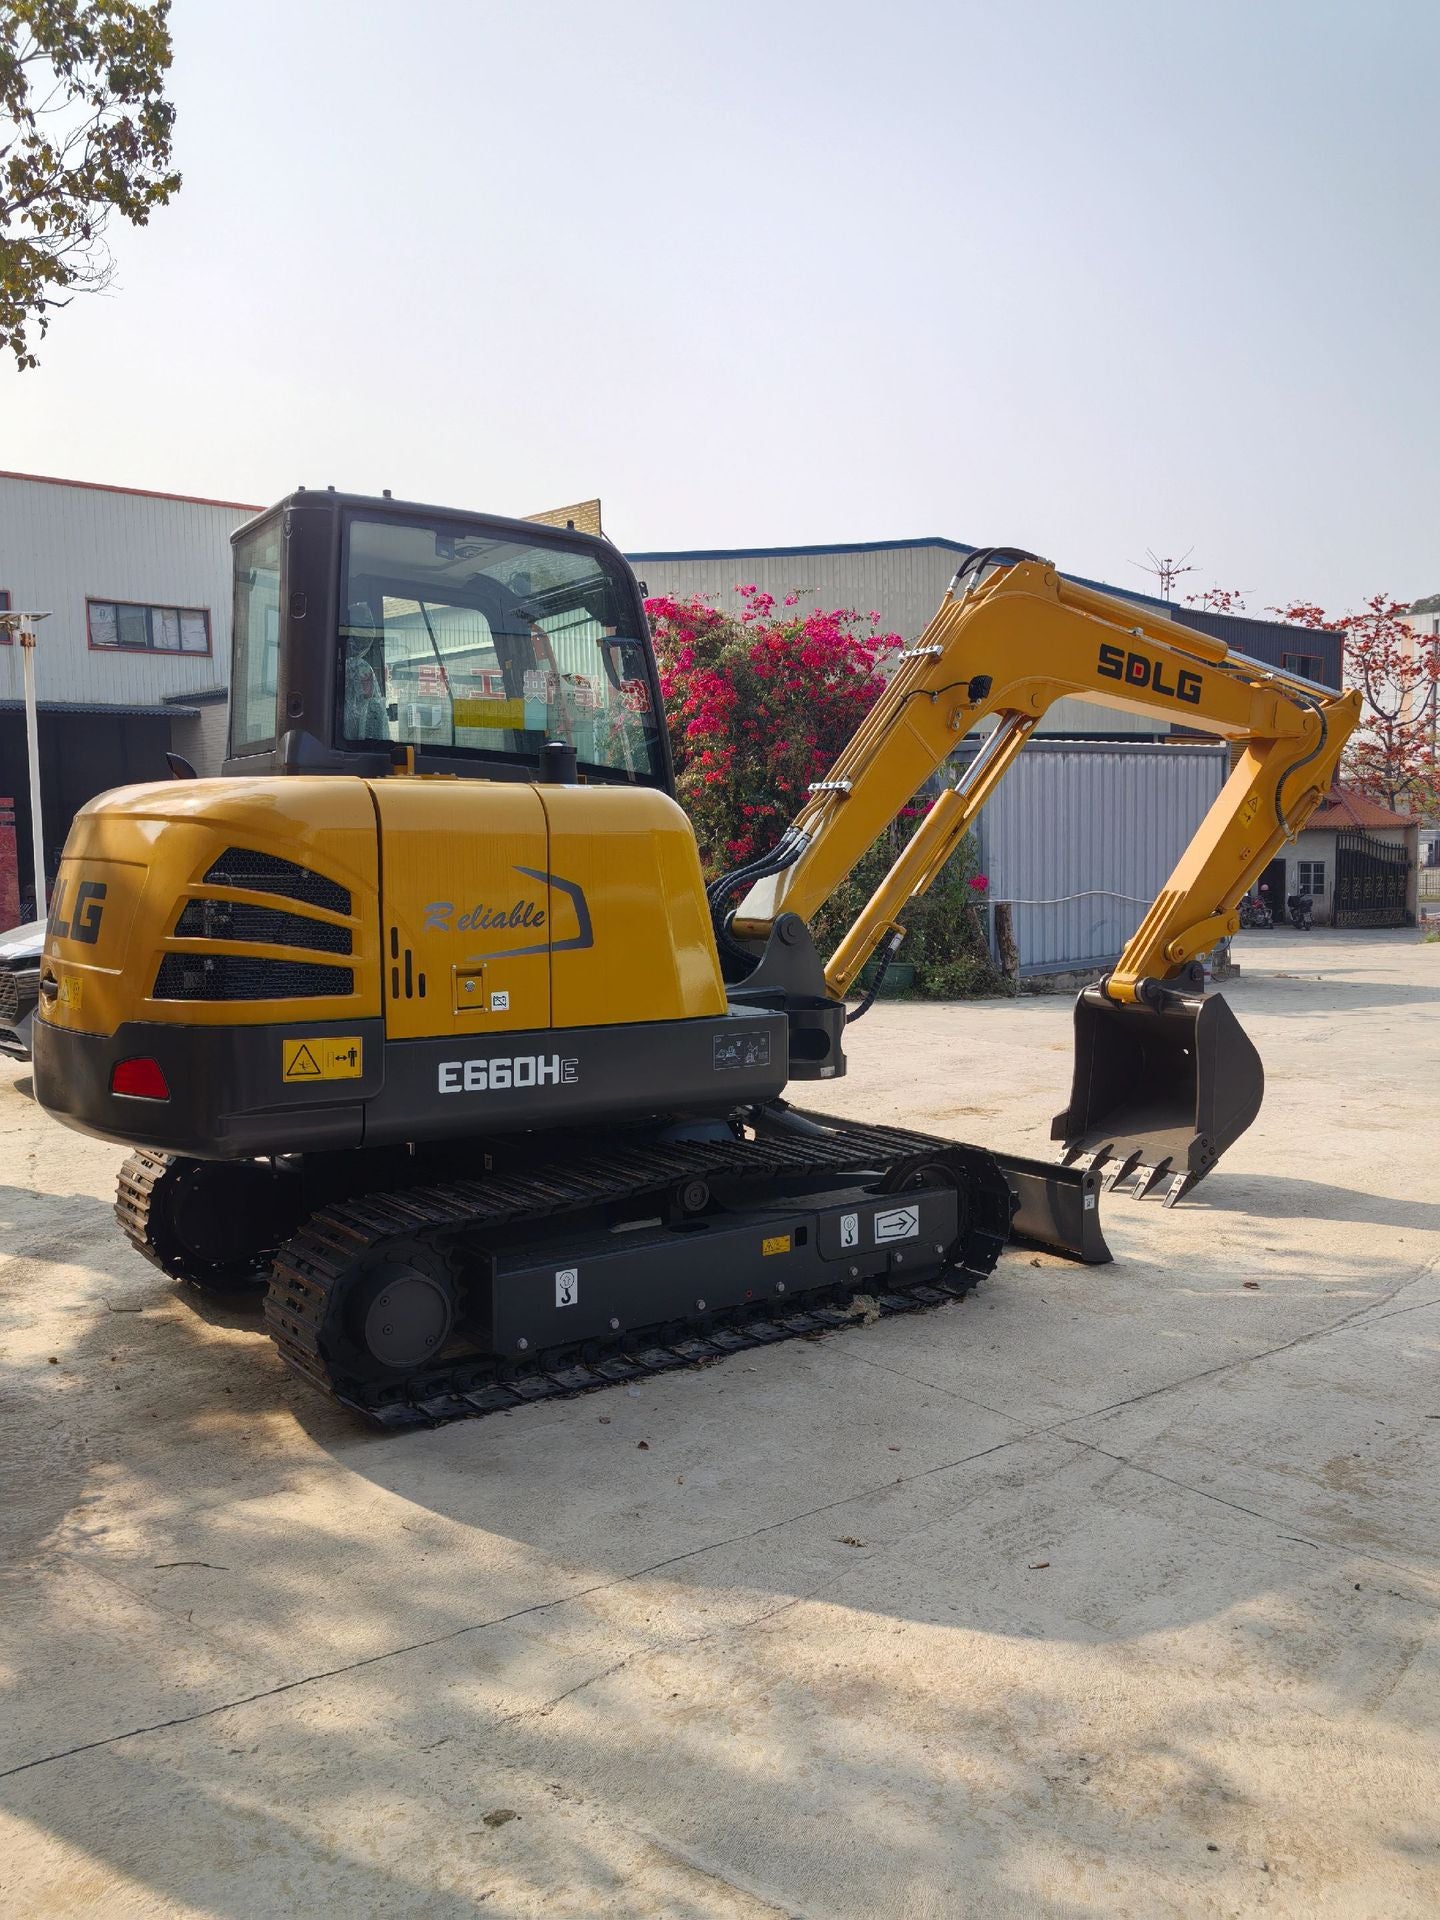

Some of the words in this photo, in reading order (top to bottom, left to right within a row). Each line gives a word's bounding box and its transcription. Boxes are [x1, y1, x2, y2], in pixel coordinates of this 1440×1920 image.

[1097, 643, 1202, 705] SDLG
[423, 900, 545, 934] Reliable
[438, 1054, 579, 1094] E660HE
